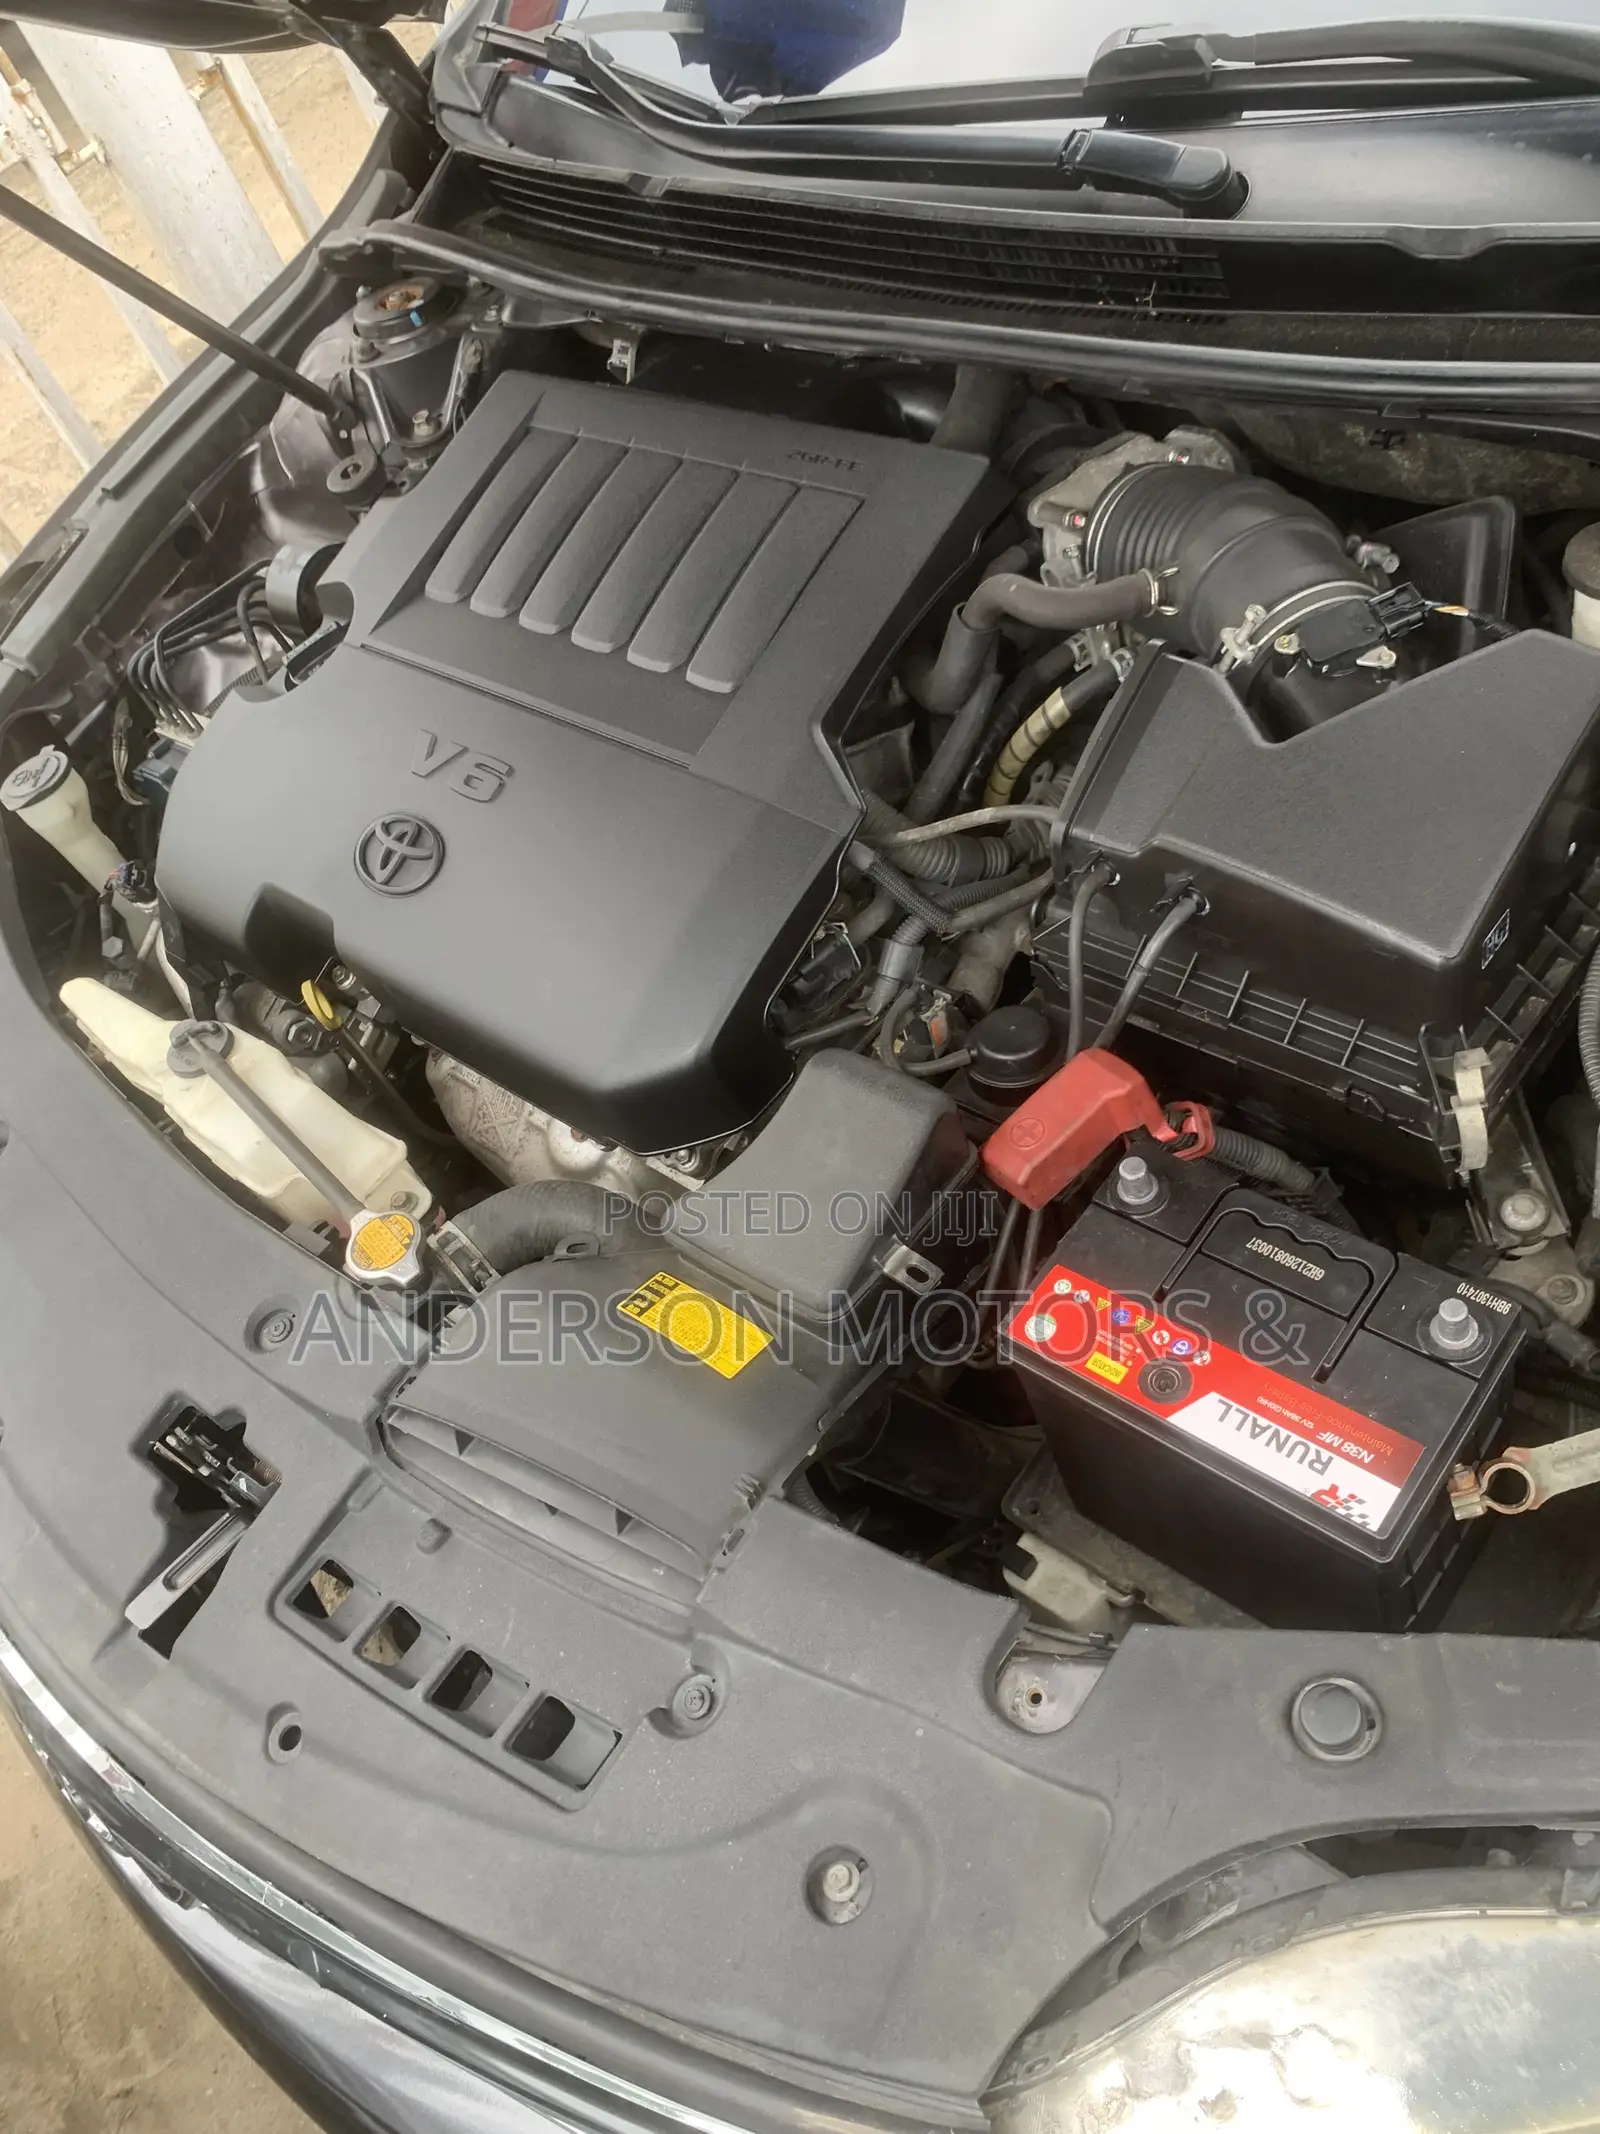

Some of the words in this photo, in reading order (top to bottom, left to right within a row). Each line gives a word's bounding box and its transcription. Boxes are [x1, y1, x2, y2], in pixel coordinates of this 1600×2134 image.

[410, 728, 516, 803] V6
[1246, 1237, 1325, 1282] 6H21260810037
[1456, 1282, 1513, 1315] 9BH1307410
[1091, 1358, 1122, 1378] INDICATOR
[1218, 1399, 1334, 1476] RUNALL
[1300, 1418, 1315, 1429] 12V
[1300, 1402, 1394, 1456] Maintenance-Free
[1316, 1431, 1344, 1448] MF
[1341, 1441, 1375, 1464] N38
